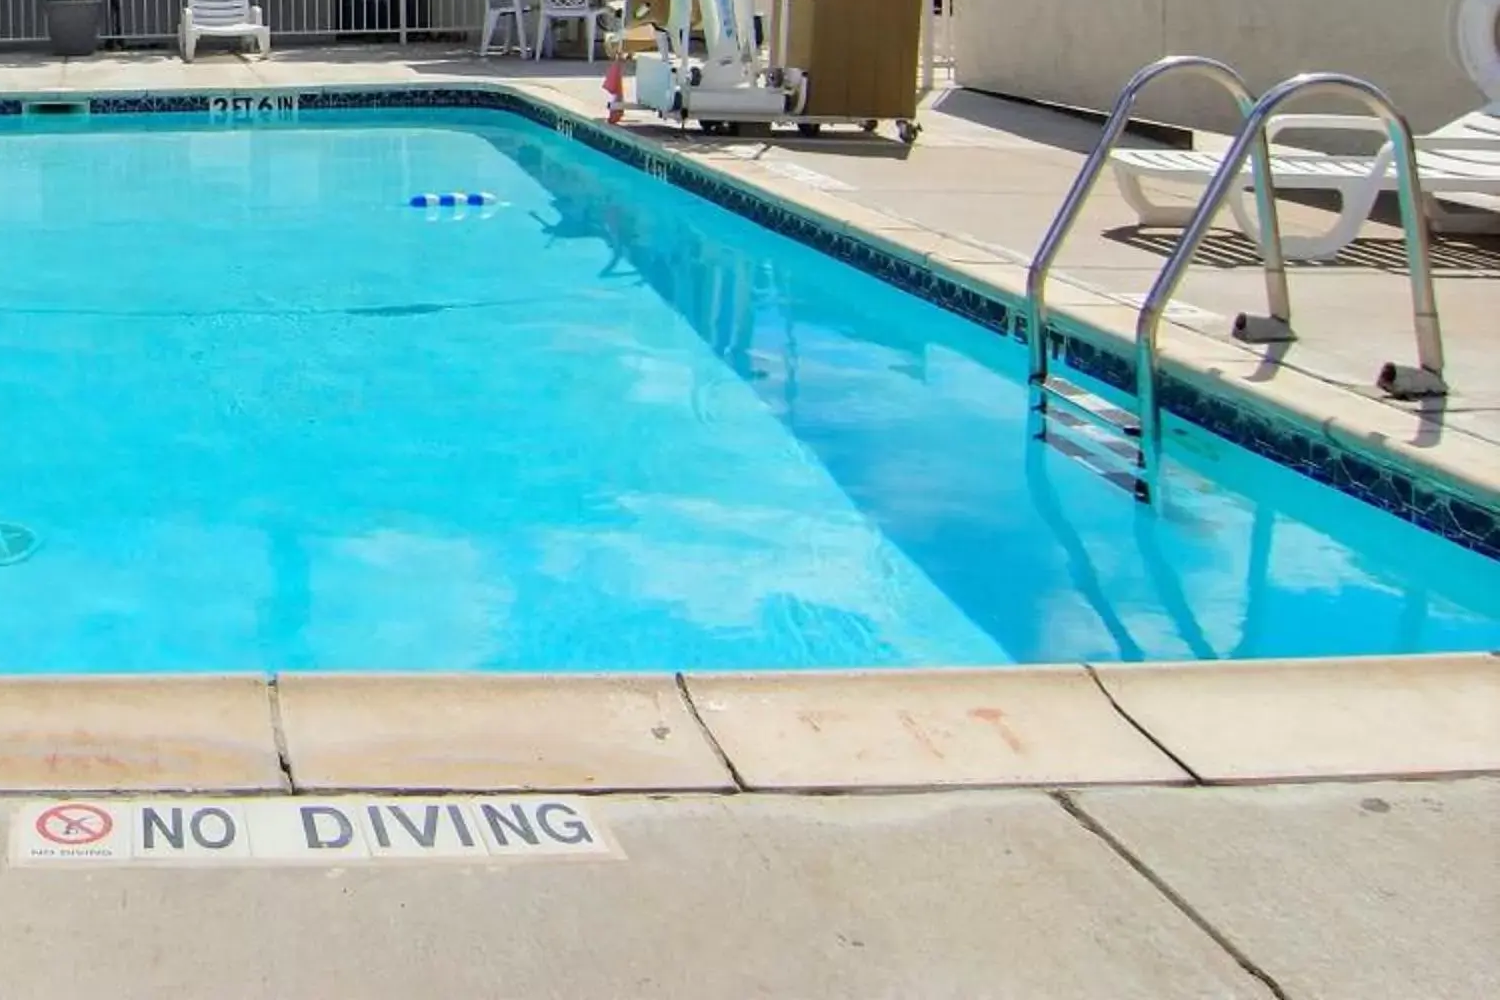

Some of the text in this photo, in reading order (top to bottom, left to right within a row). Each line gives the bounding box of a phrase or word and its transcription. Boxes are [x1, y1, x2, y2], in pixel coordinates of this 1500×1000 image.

[278, 95, 293, 113] IN
[142, 802, 594, 850] NO DIVING
